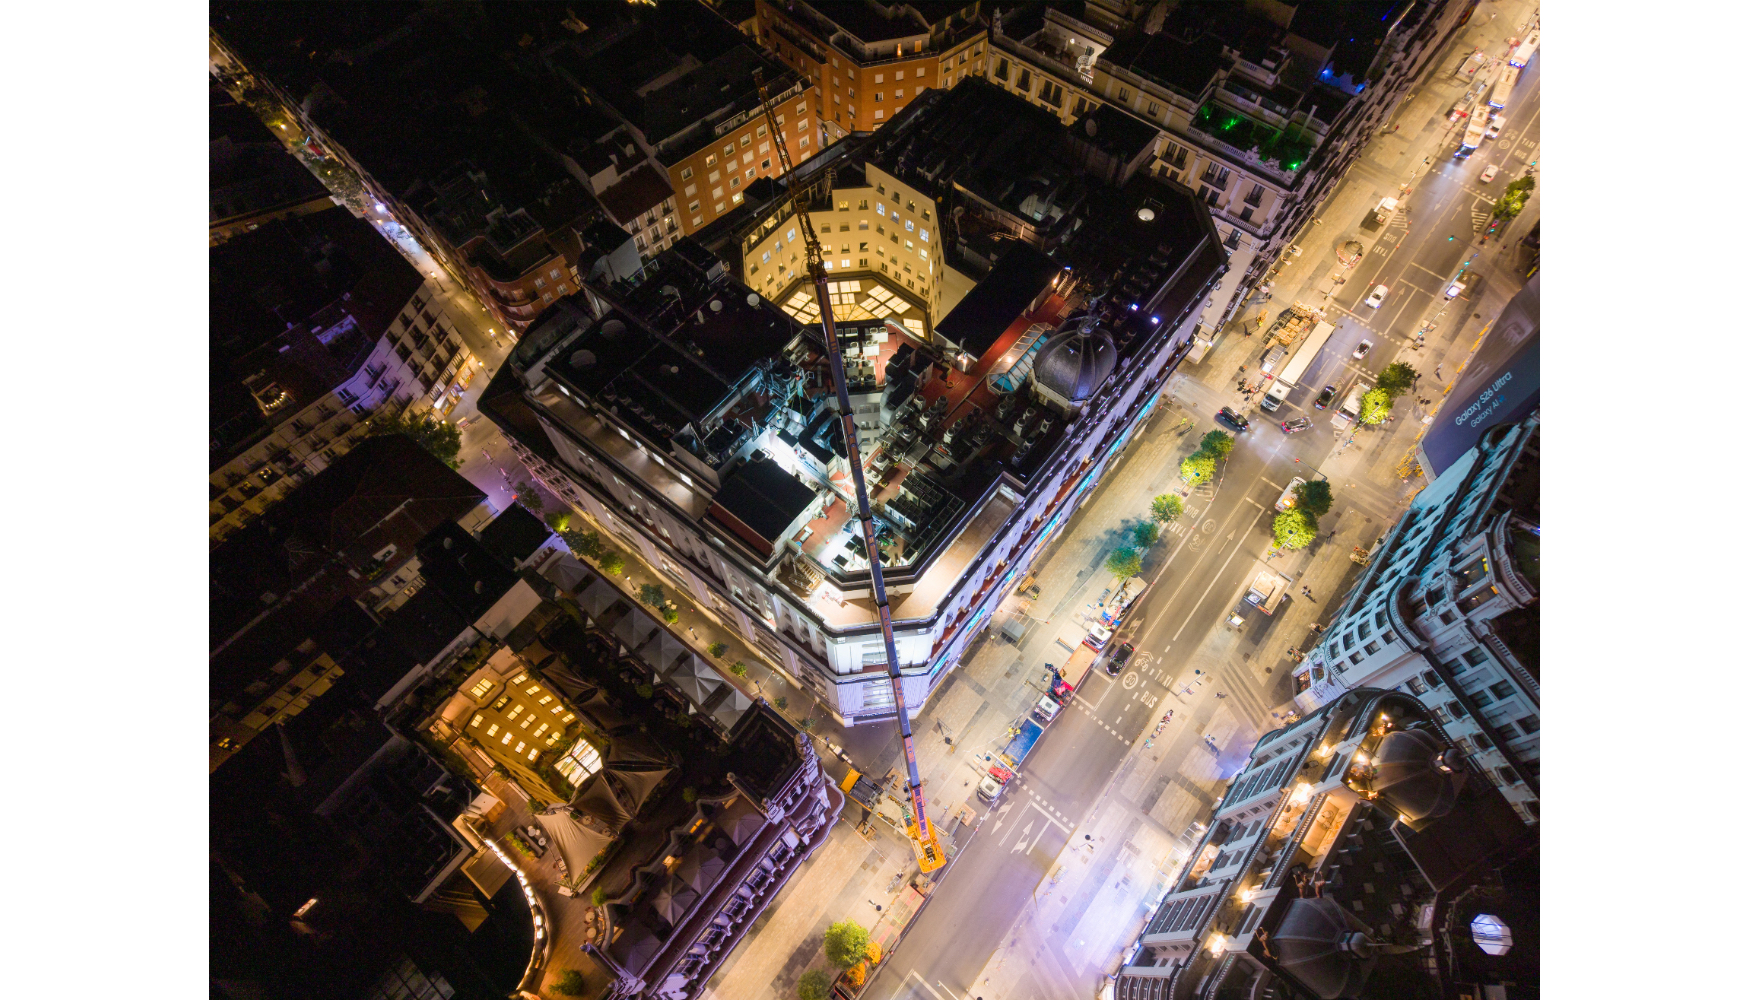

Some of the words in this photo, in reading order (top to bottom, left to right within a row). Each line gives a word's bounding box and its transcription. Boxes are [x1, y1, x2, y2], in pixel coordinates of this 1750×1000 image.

[1455, 399, 1481, 425] Galaxy
[1479, 388, 1494, 404] S26
[1492, 371, 1512, 392] Ultra
[1470, 406, 1493, 428] Galaxy
[1492, 399, 1500, 409] AI
[1183, 504, 1200, 519] BUS
[1169, 520, 1187, 537] TAXI
[1125, 675, 1136, 686] 30
[1154, 668, 1174, 688] TAXI
[1140, 690, 1158, 709] BUS
